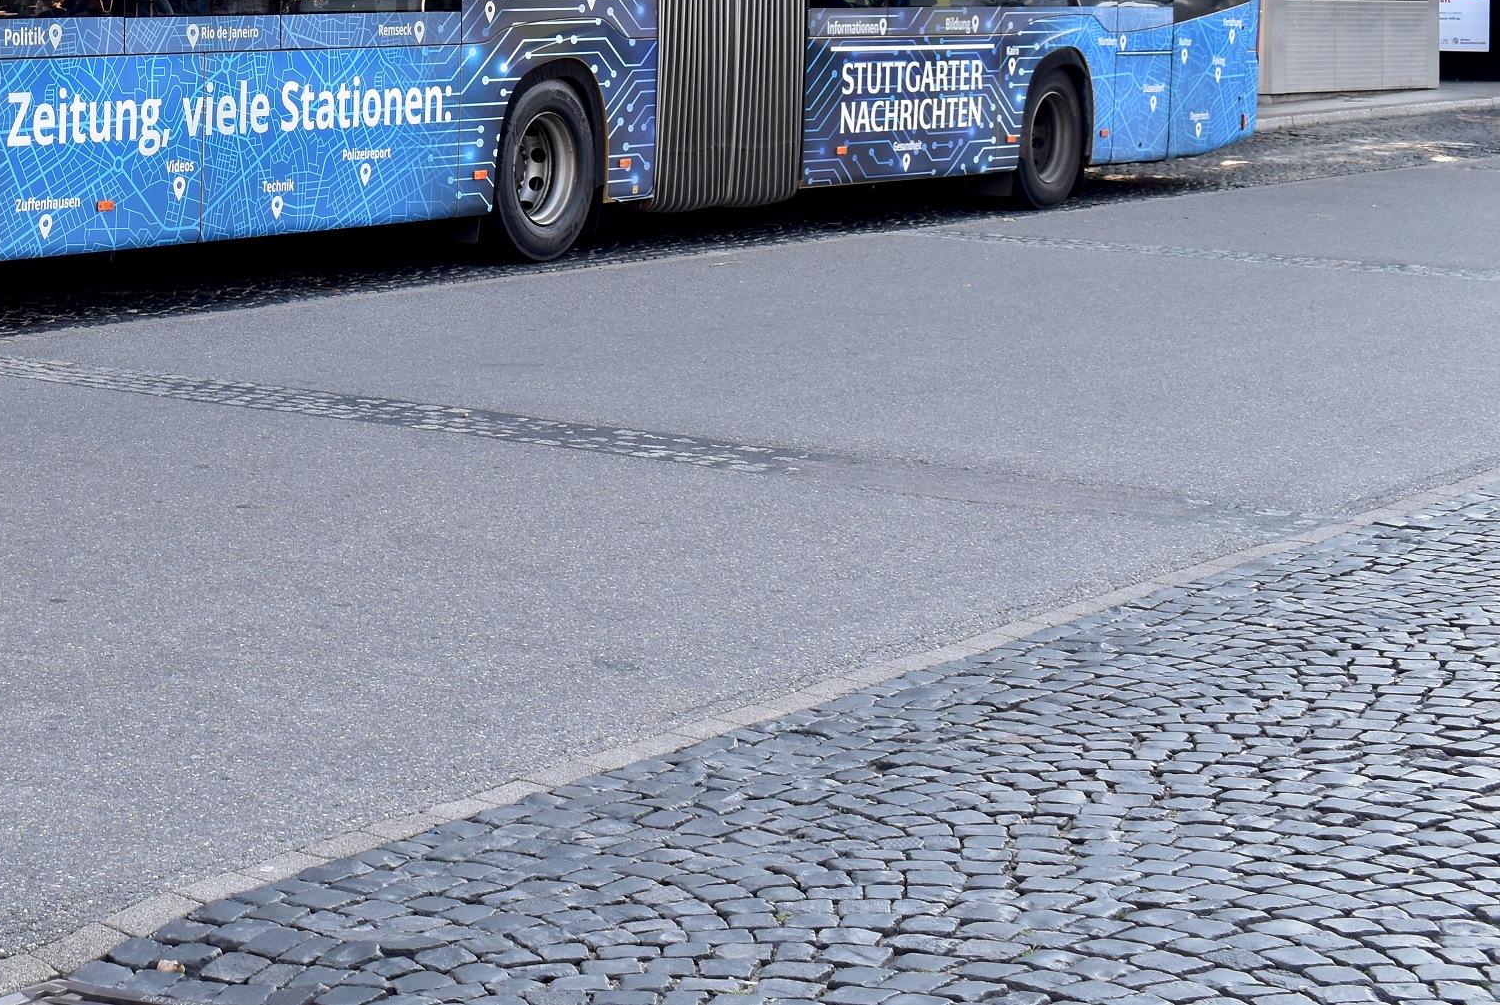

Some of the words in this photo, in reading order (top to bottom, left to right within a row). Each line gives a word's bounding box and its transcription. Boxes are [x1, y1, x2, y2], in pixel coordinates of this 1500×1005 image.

[378, 24, 412, 37] Remseck
[827, 20, 879, 34] Informationen
[945, 17, 971, 33] Bildung
[4, 27, 46, 46] Politik
[201, 27, 216, 39] Rio
[218, 26, 228, 38] de
[229, 26, 259, 40] Janeiro
[1006, 46, 1019, 56] Kairo
[841, 59, 983, 95] STUTTGARTER
[7, 87, 170, 156] Zeitung,
[183, 79, 270, 137] viele
[281, 76, 452, 132] Stationen:
[840, 96, 983, 134] NACHRICHTEN
[342, 147, 392, 161] Polizeireport
[166, 160, 194, 174] Videos
[262, 180, 294, 193] Technik
[15, 196, 81, 212] Zuffenhausen
